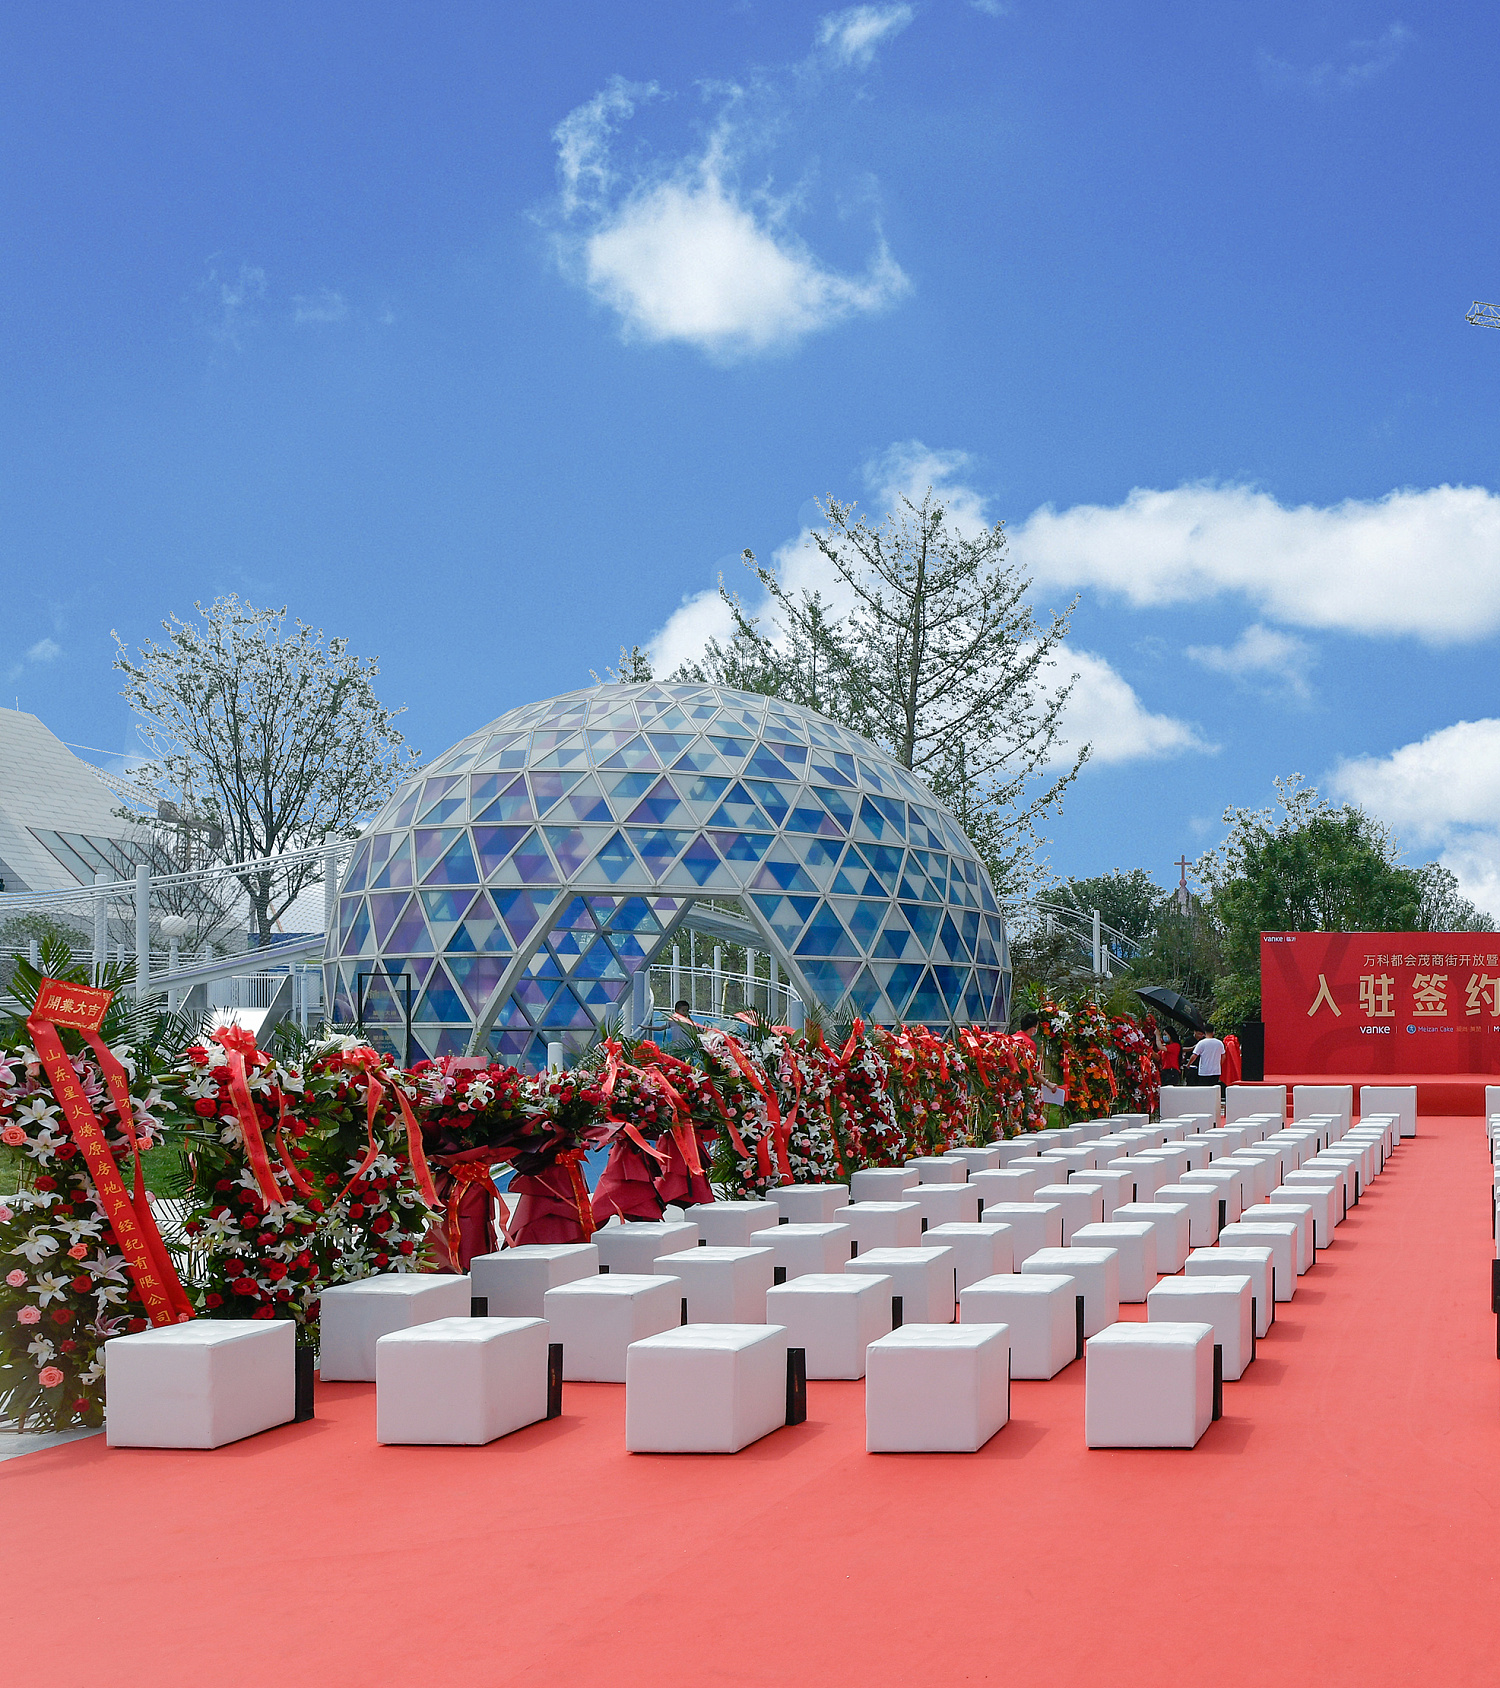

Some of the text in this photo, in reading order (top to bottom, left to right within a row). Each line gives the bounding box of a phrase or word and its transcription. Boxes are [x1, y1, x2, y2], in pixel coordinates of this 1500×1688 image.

[44, 993, 102, 1018] 開業大吉
[1359, 1025, 1391, 1034] vanke
[45, 1048, 173, 1323] 山东星火燎原房地产经纪有限公司
